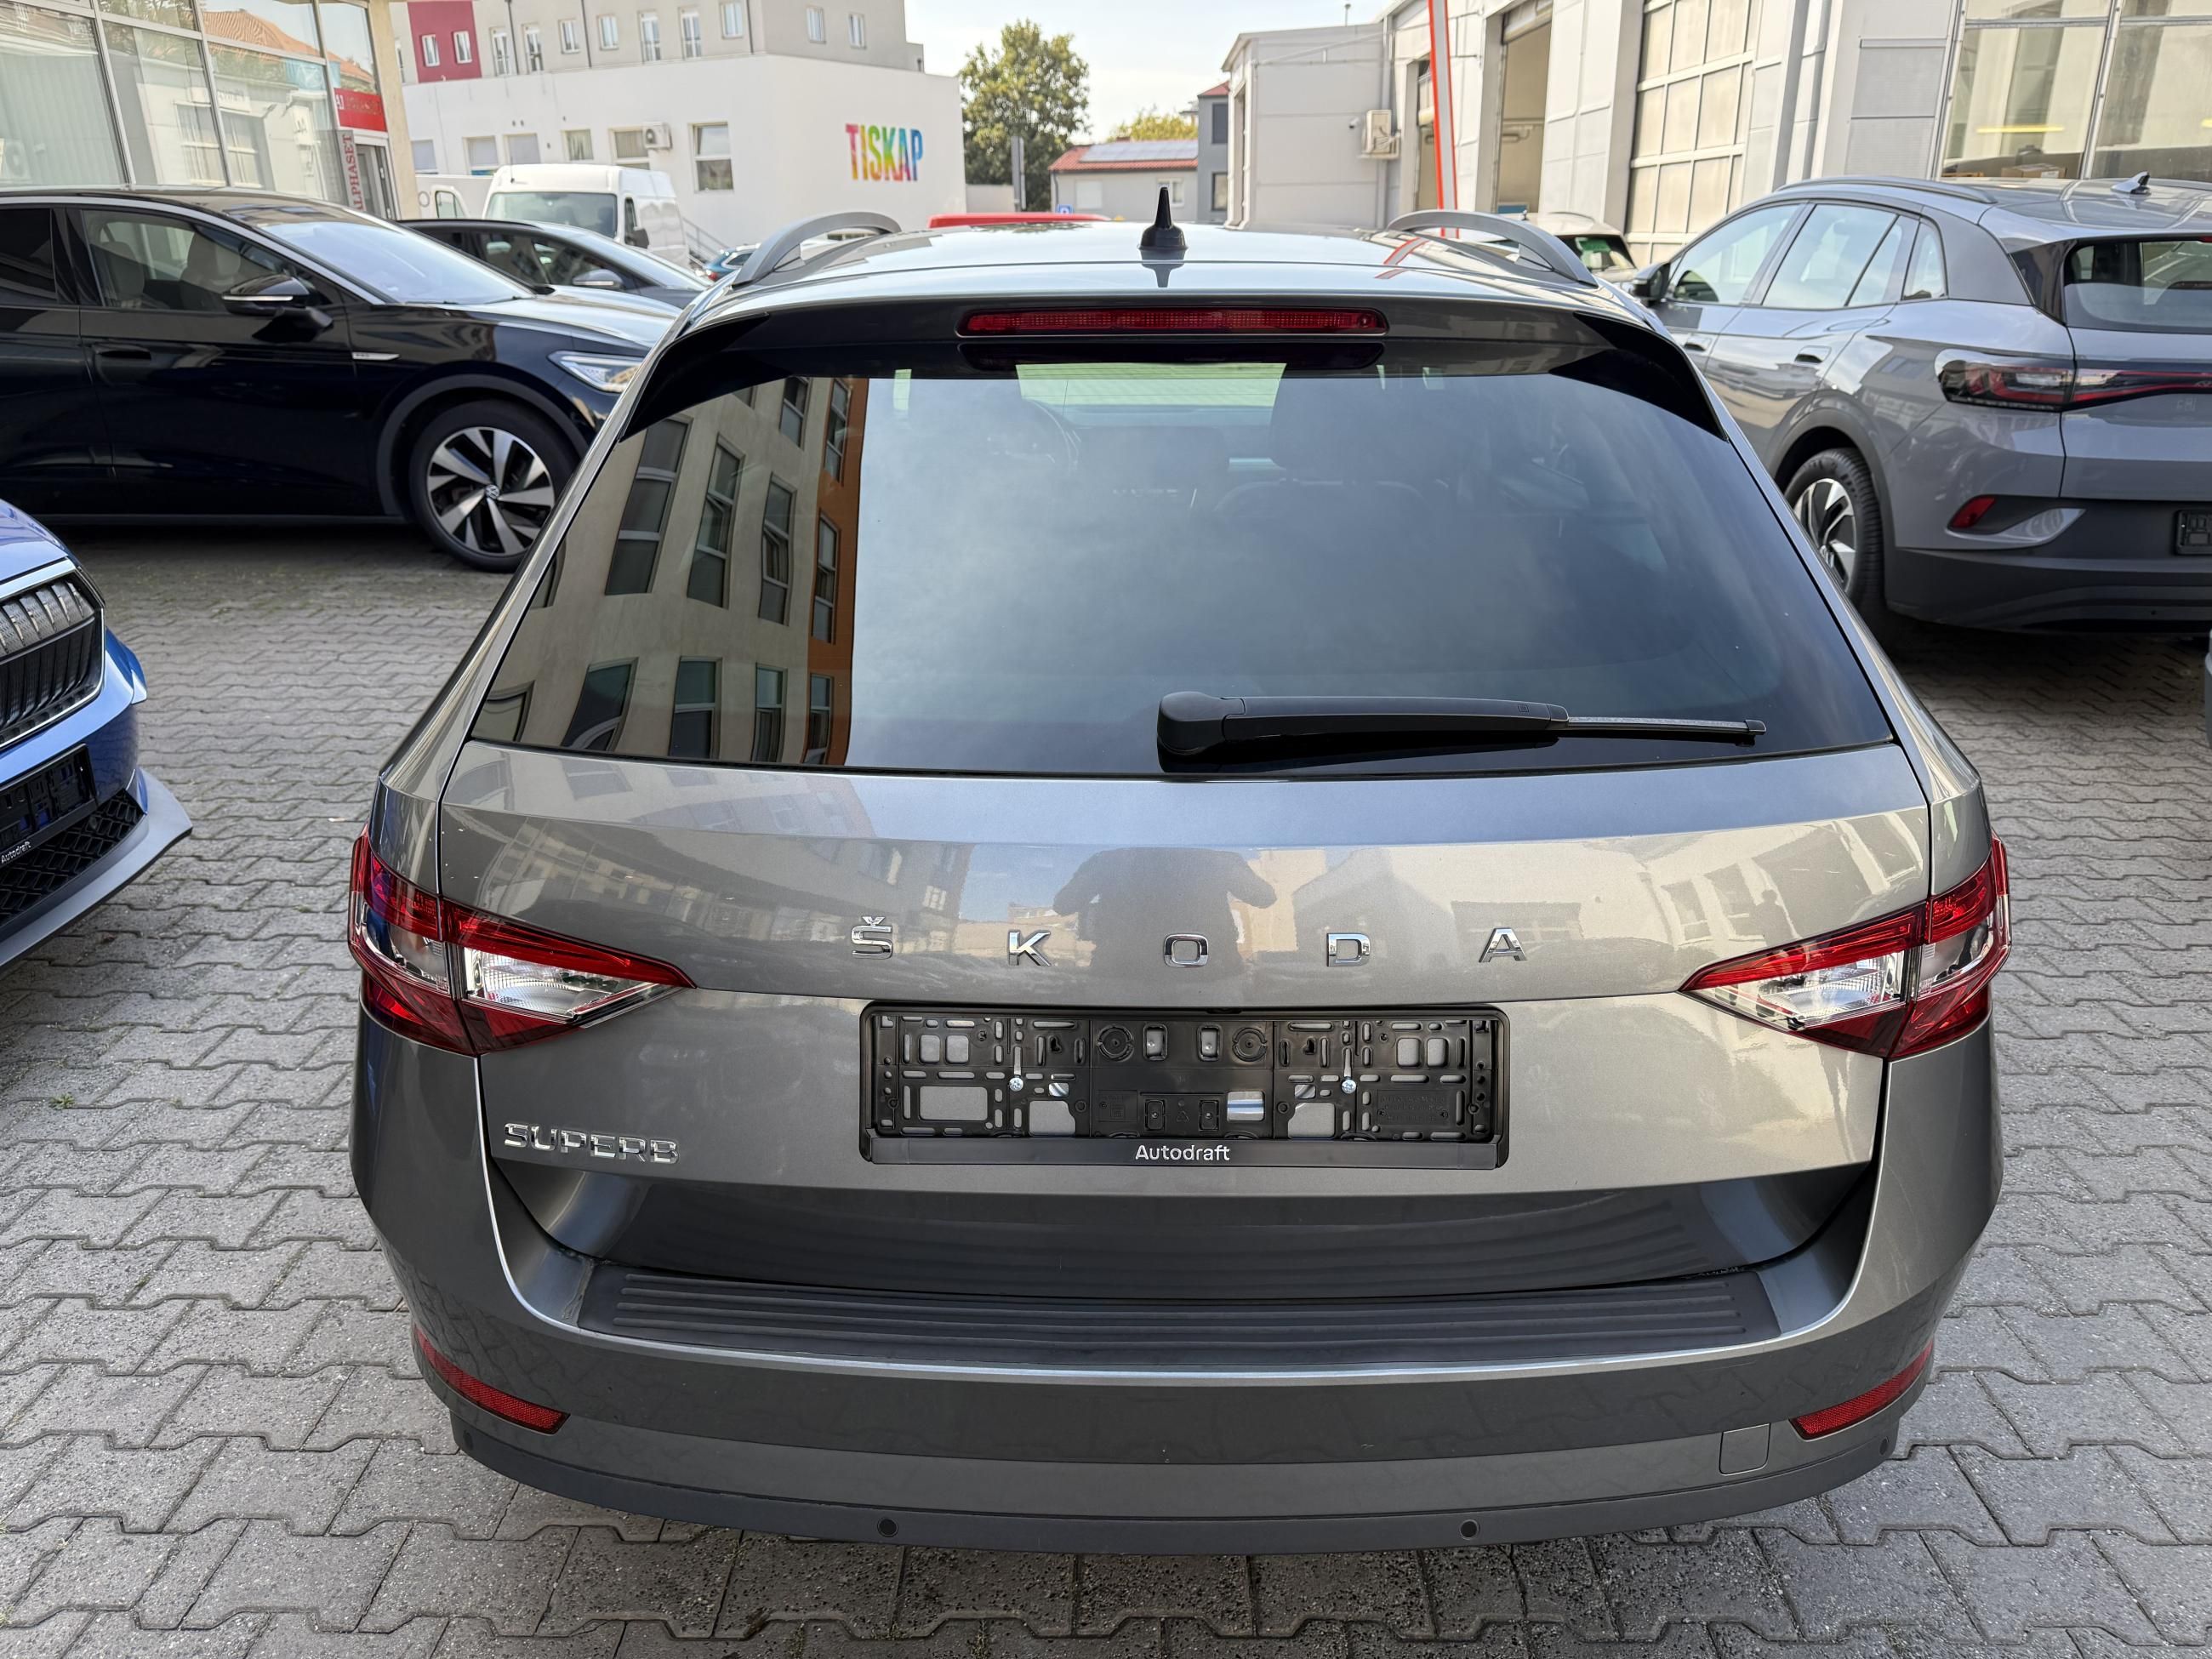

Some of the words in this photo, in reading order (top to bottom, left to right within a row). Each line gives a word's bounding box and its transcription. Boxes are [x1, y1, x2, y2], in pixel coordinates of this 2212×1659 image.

[846, 123, 923, 181] TISKAP
[851, 915, 1527, 968] ŠKODA
[504, 1122, 679, 1164] SUPERB
[1134, 1144, 1230, 1161] Autodraft
